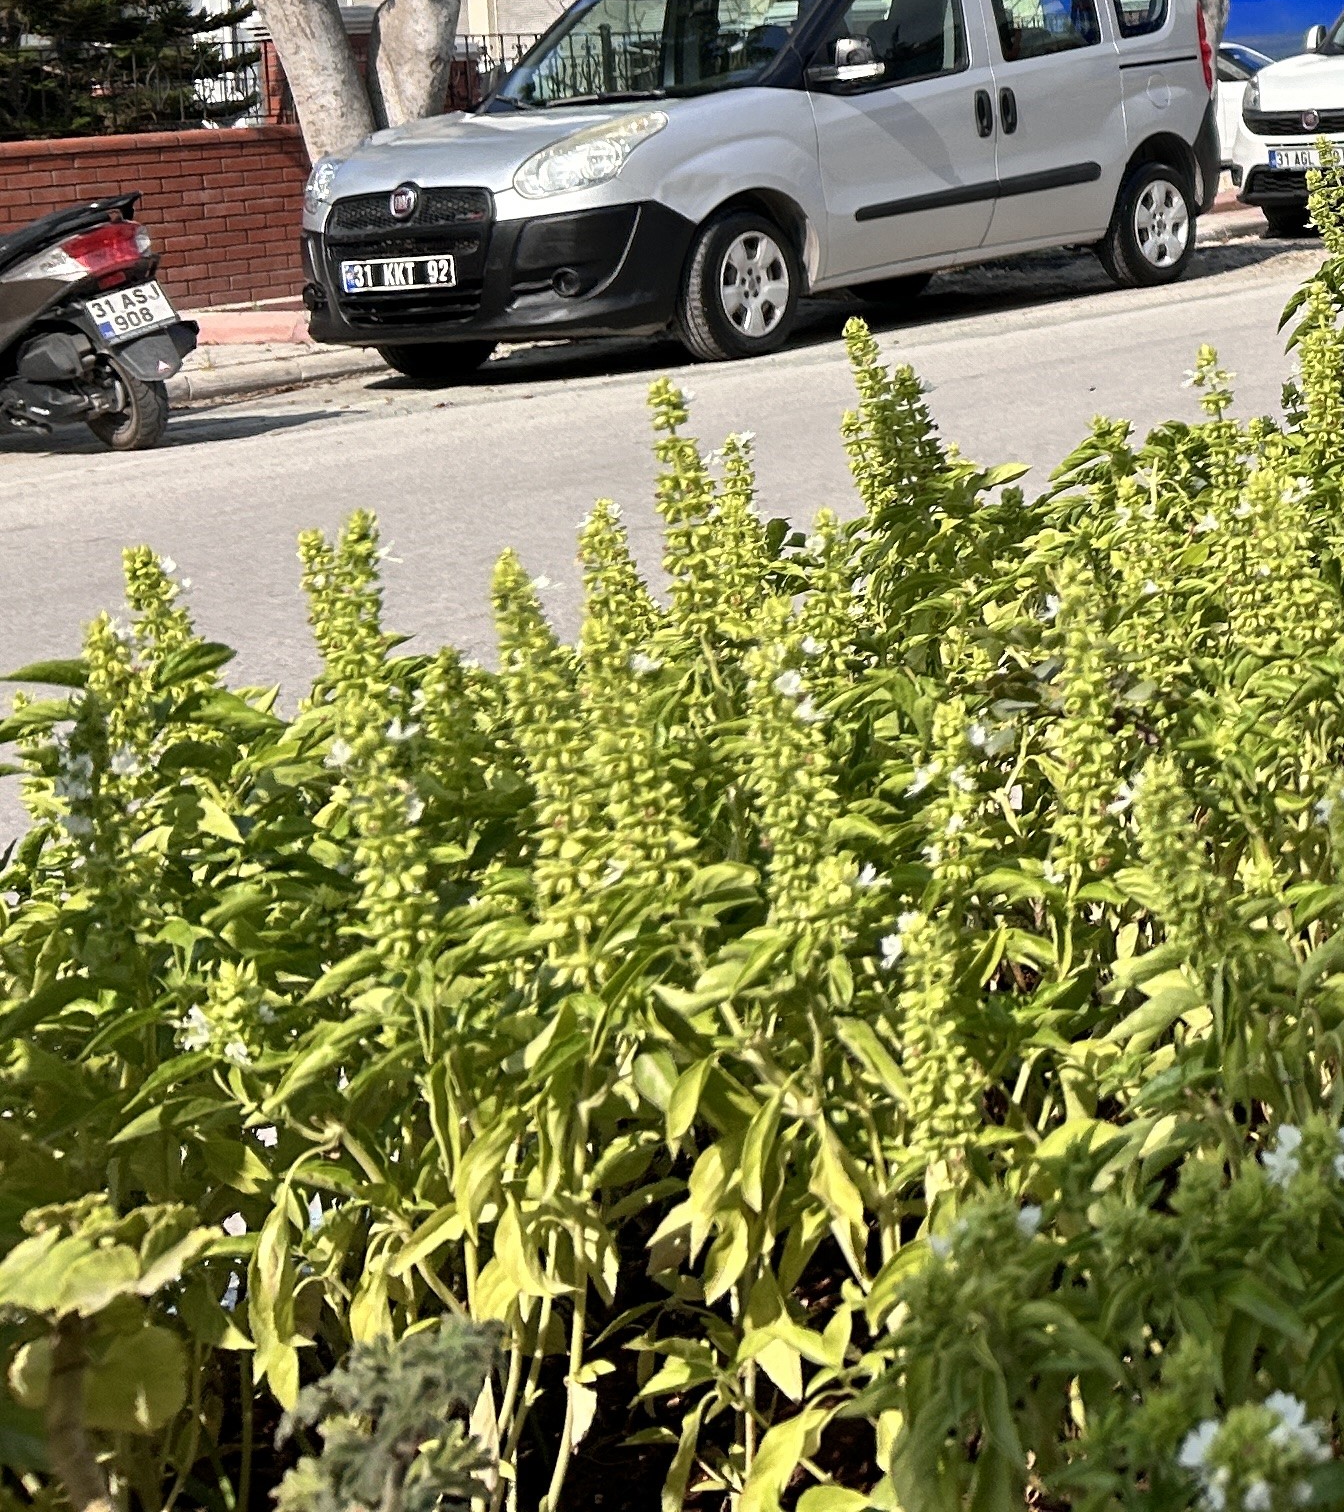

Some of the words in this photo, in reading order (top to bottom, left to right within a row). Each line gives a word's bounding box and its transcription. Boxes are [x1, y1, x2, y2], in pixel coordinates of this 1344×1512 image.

[1276, 151, 1290, 167] 31
[1295, 150, 1315, 166] AGL
[354, 264, 373, 288] 31
[383, 261, 415, 287] KKT
[427, 259, 449, 284] 92
[91, 298, 116, 319] 31
[121, 283, 160, 310] ASJ
[114, 306, 154, 331] 908
